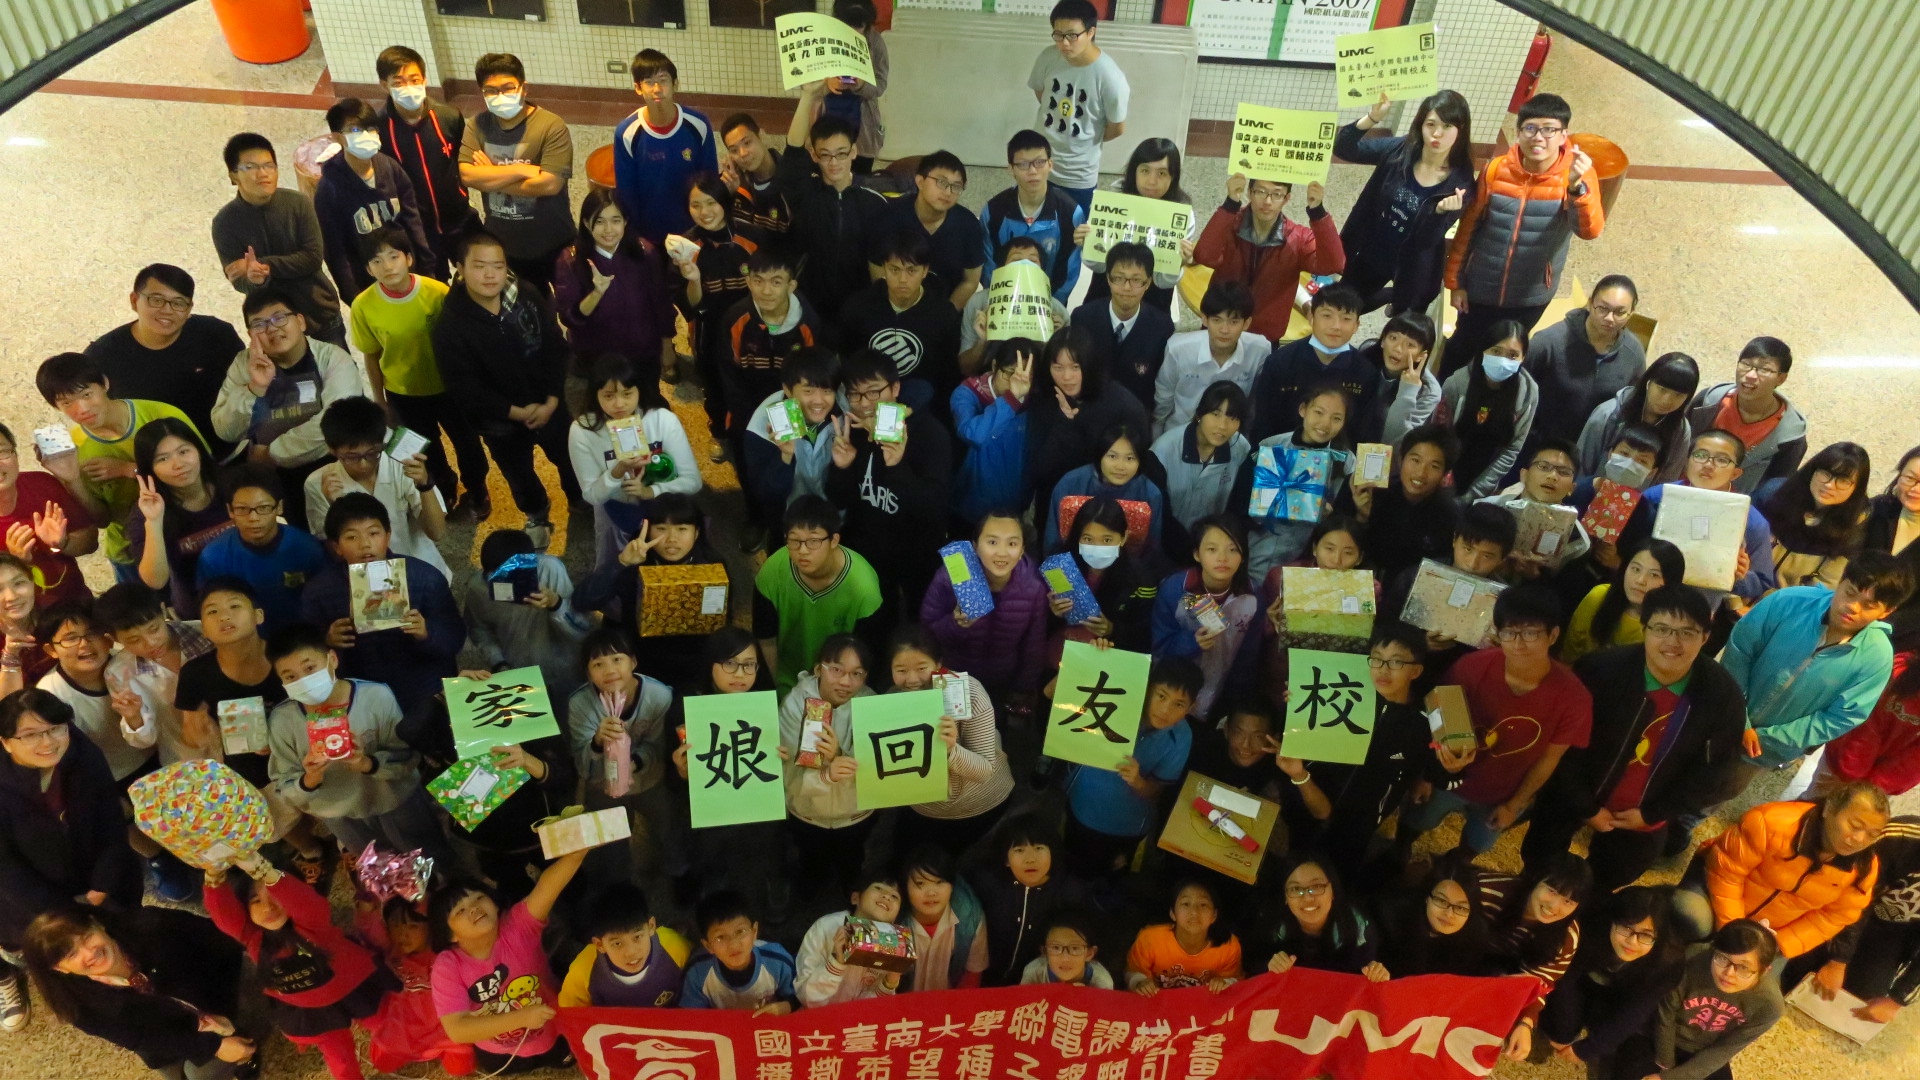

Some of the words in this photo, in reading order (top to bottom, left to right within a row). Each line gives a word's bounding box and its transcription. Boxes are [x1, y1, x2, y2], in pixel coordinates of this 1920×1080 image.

[780, 25, 814, 39] UMC
[1338, 46, 1375, 58] UMC
[1347, 70, 1385, 84] 第十一屆
[1389, 64, 1428, 77] 課輔校友
[1238, 118, 1275, 130] UMC
[1284, 149, 1325, 162] 課輔校友
[1094, 204, 1129, 216] UMC
[990, 280, 1014, 291] UMC
[858, 452, 899, 514] ARIS
[465, 683, 548, 728] 家
[1058, 671, 1130, 743] 友
[1294, 666, 1370, 735] 校
[695, 720, 780, 790] 娘
[869, 723, 933, 780] 回
[1248, 1009, 1504, 1076] UMC
